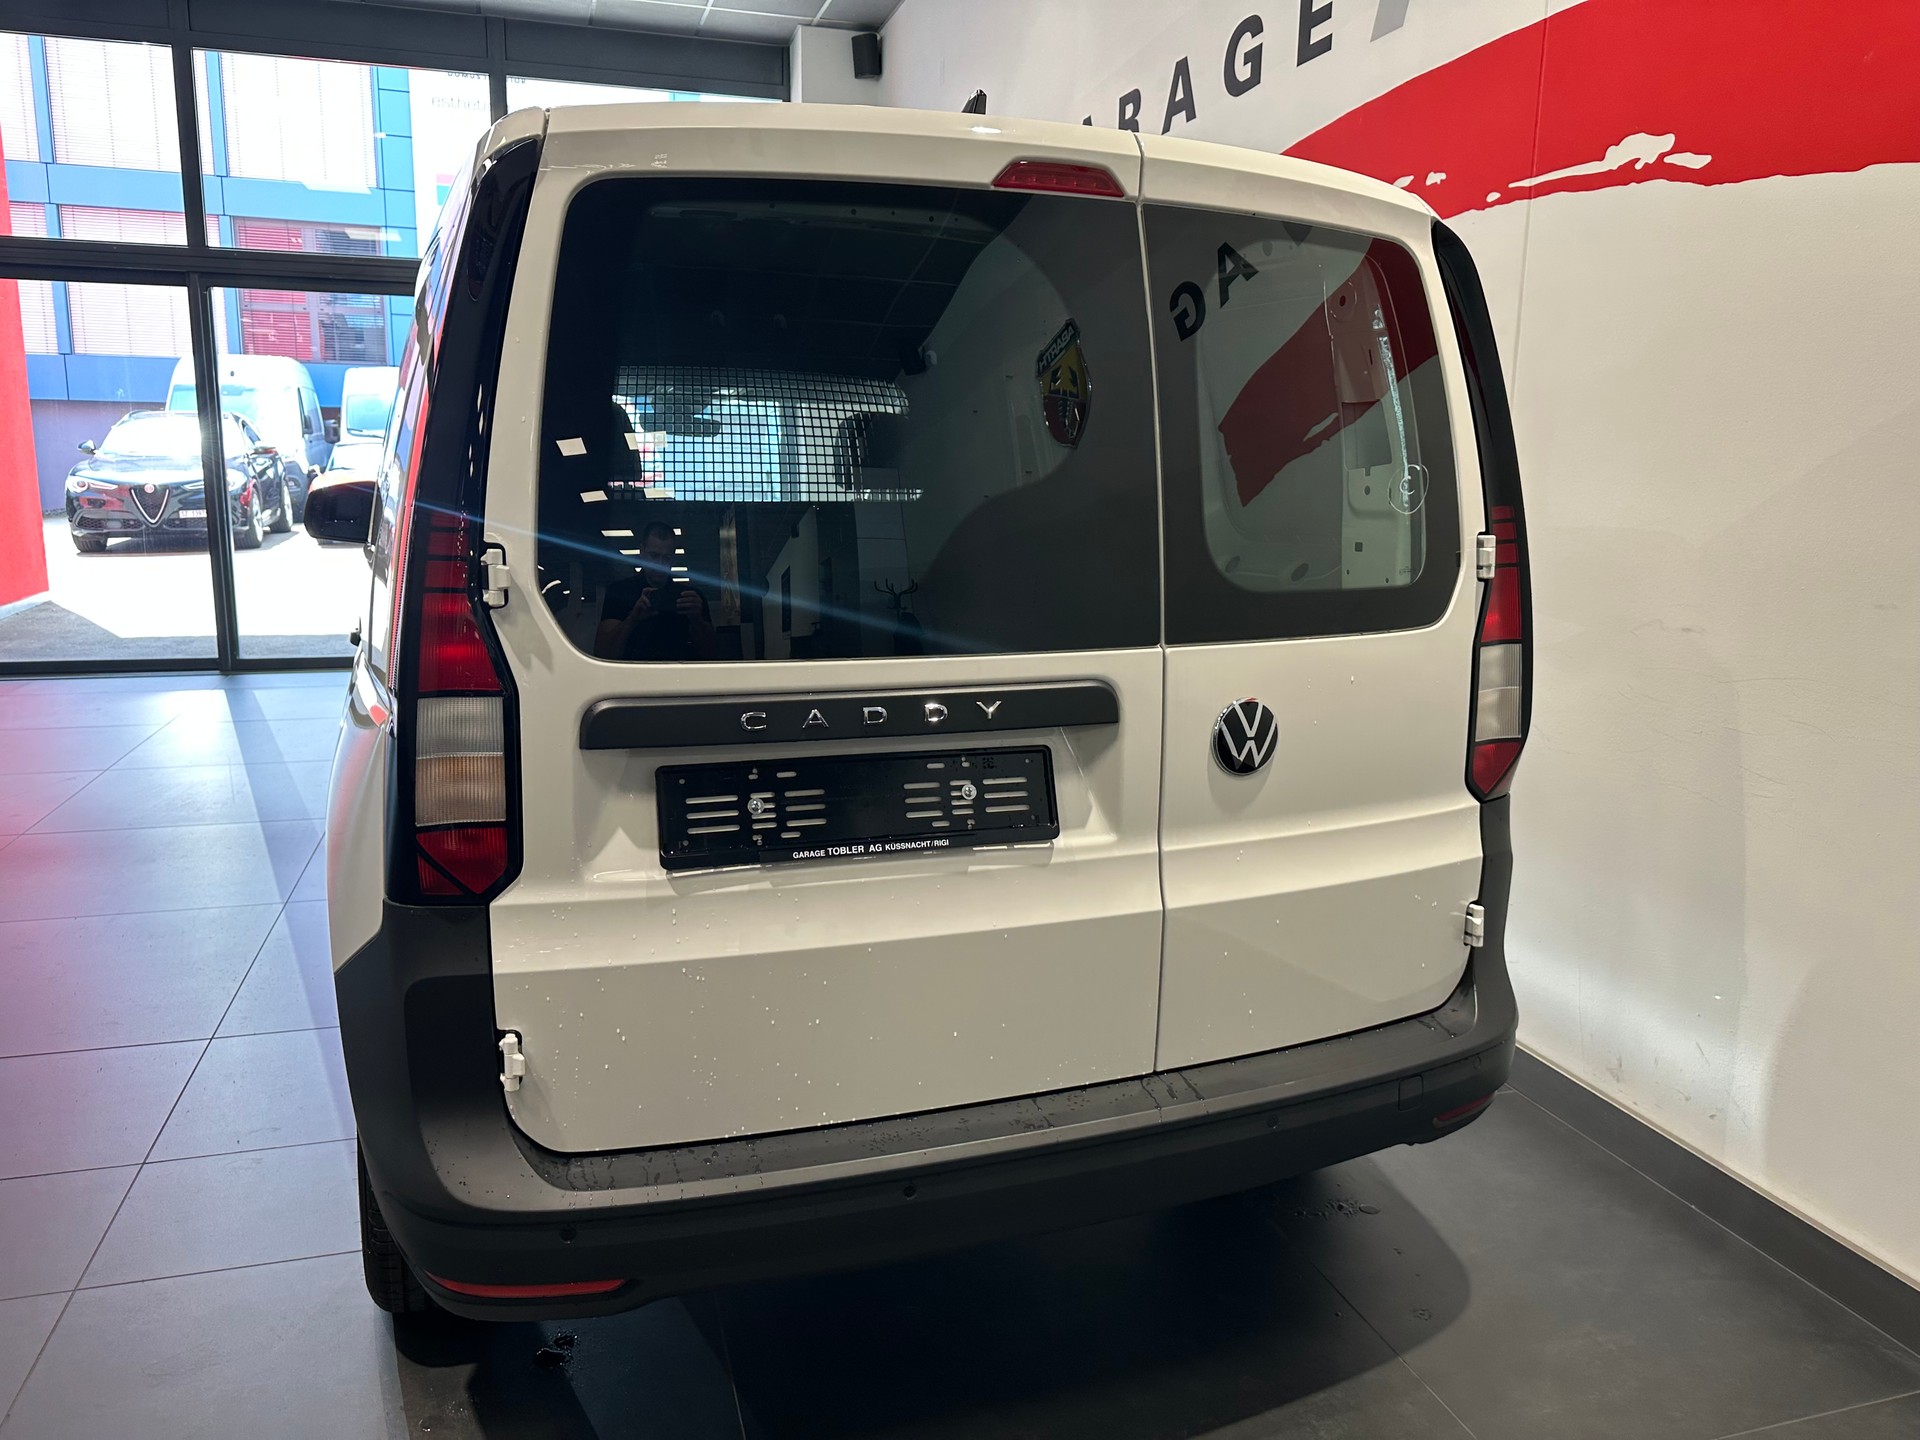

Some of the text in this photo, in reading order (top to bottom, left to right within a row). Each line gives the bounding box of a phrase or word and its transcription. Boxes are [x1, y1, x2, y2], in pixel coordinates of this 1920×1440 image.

[740, 700, 1002, 731] CADDY
[1216, 699, 1278, 772] VW
[792, 839, 950, 859] GARAGE TOBLER AG KÜSSNACHT/RIGI
